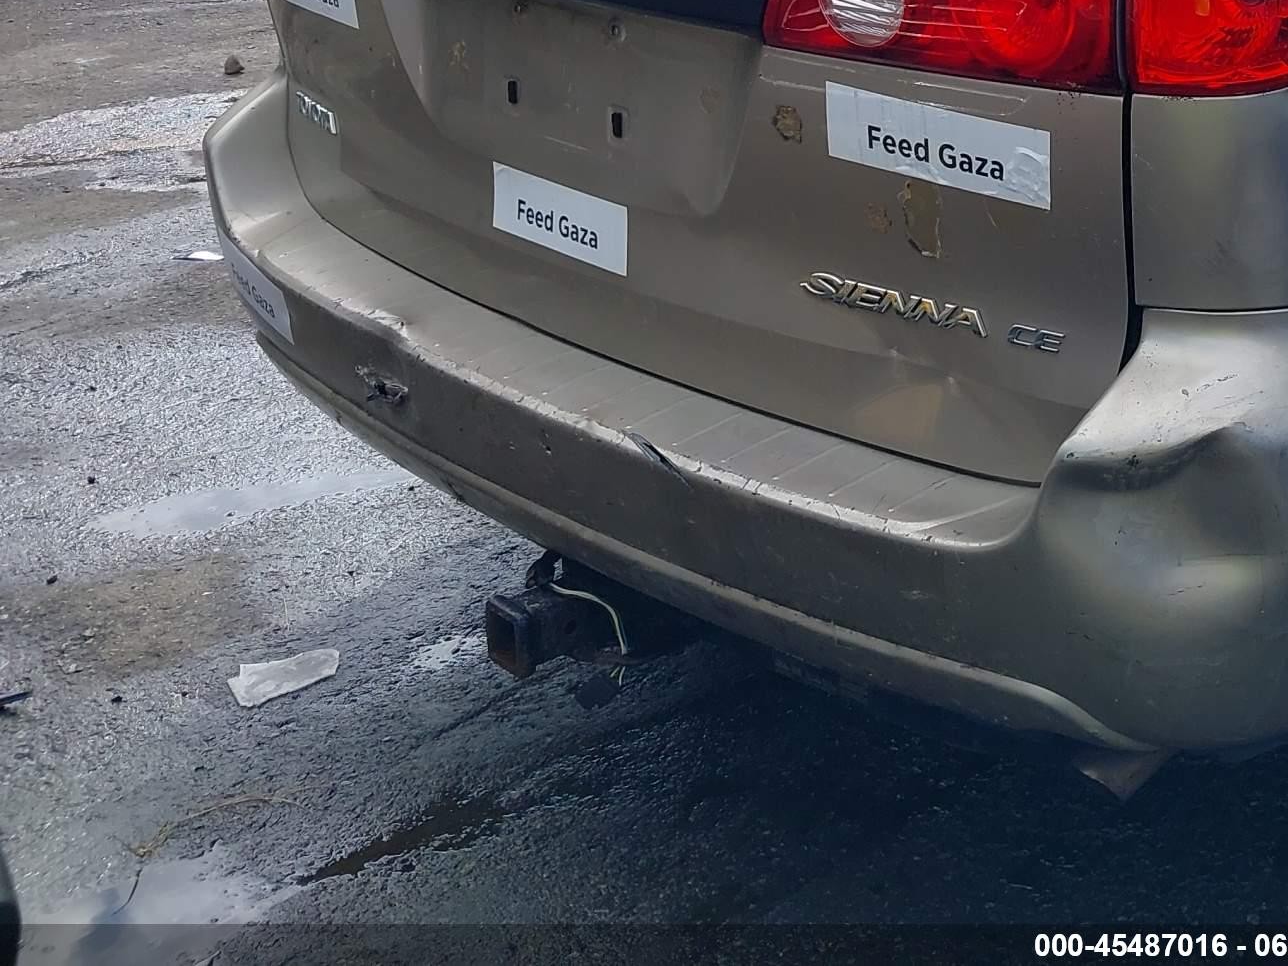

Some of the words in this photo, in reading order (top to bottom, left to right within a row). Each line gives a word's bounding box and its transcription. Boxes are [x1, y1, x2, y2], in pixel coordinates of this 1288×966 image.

[296, 91, 337, 135] TOYOTA
[867, 125, 930, 164] Feed
[938, 144, 1004, 181] Gaza
[517, 199, 554, 233] Feed
[558, 215, 598, 250] Gaza
[252, 285, 276, 319] Gaza
[800, 272, 988, 338] SIENNA
[1007, 324, 1066, 353] CE
